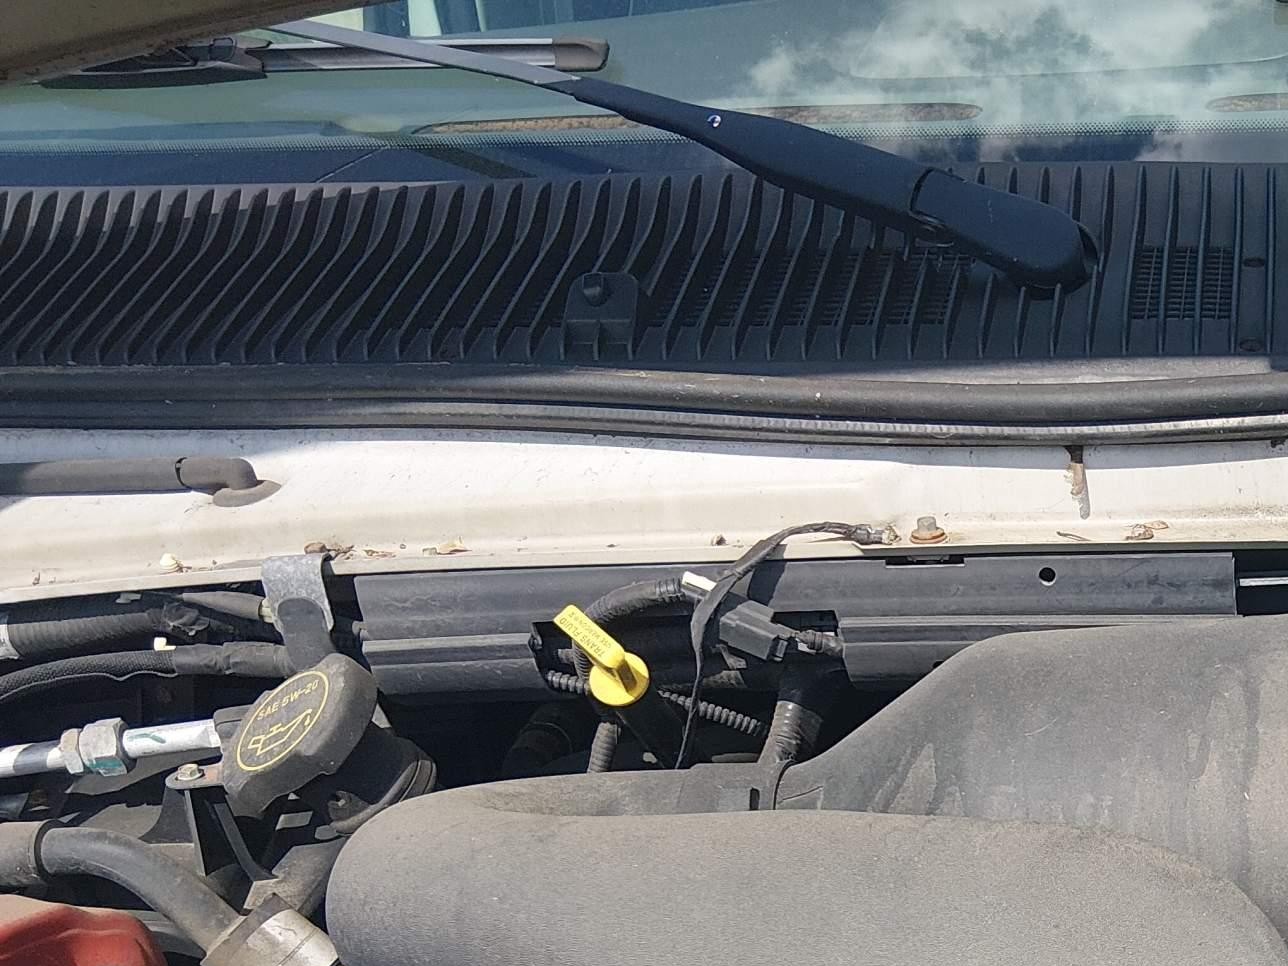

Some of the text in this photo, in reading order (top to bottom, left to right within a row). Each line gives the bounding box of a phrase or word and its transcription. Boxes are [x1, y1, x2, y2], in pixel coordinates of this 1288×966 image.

[559, 618, 605, 657] TRANS FLUID
[257, 679, 319, 720] SAE 5W-20
